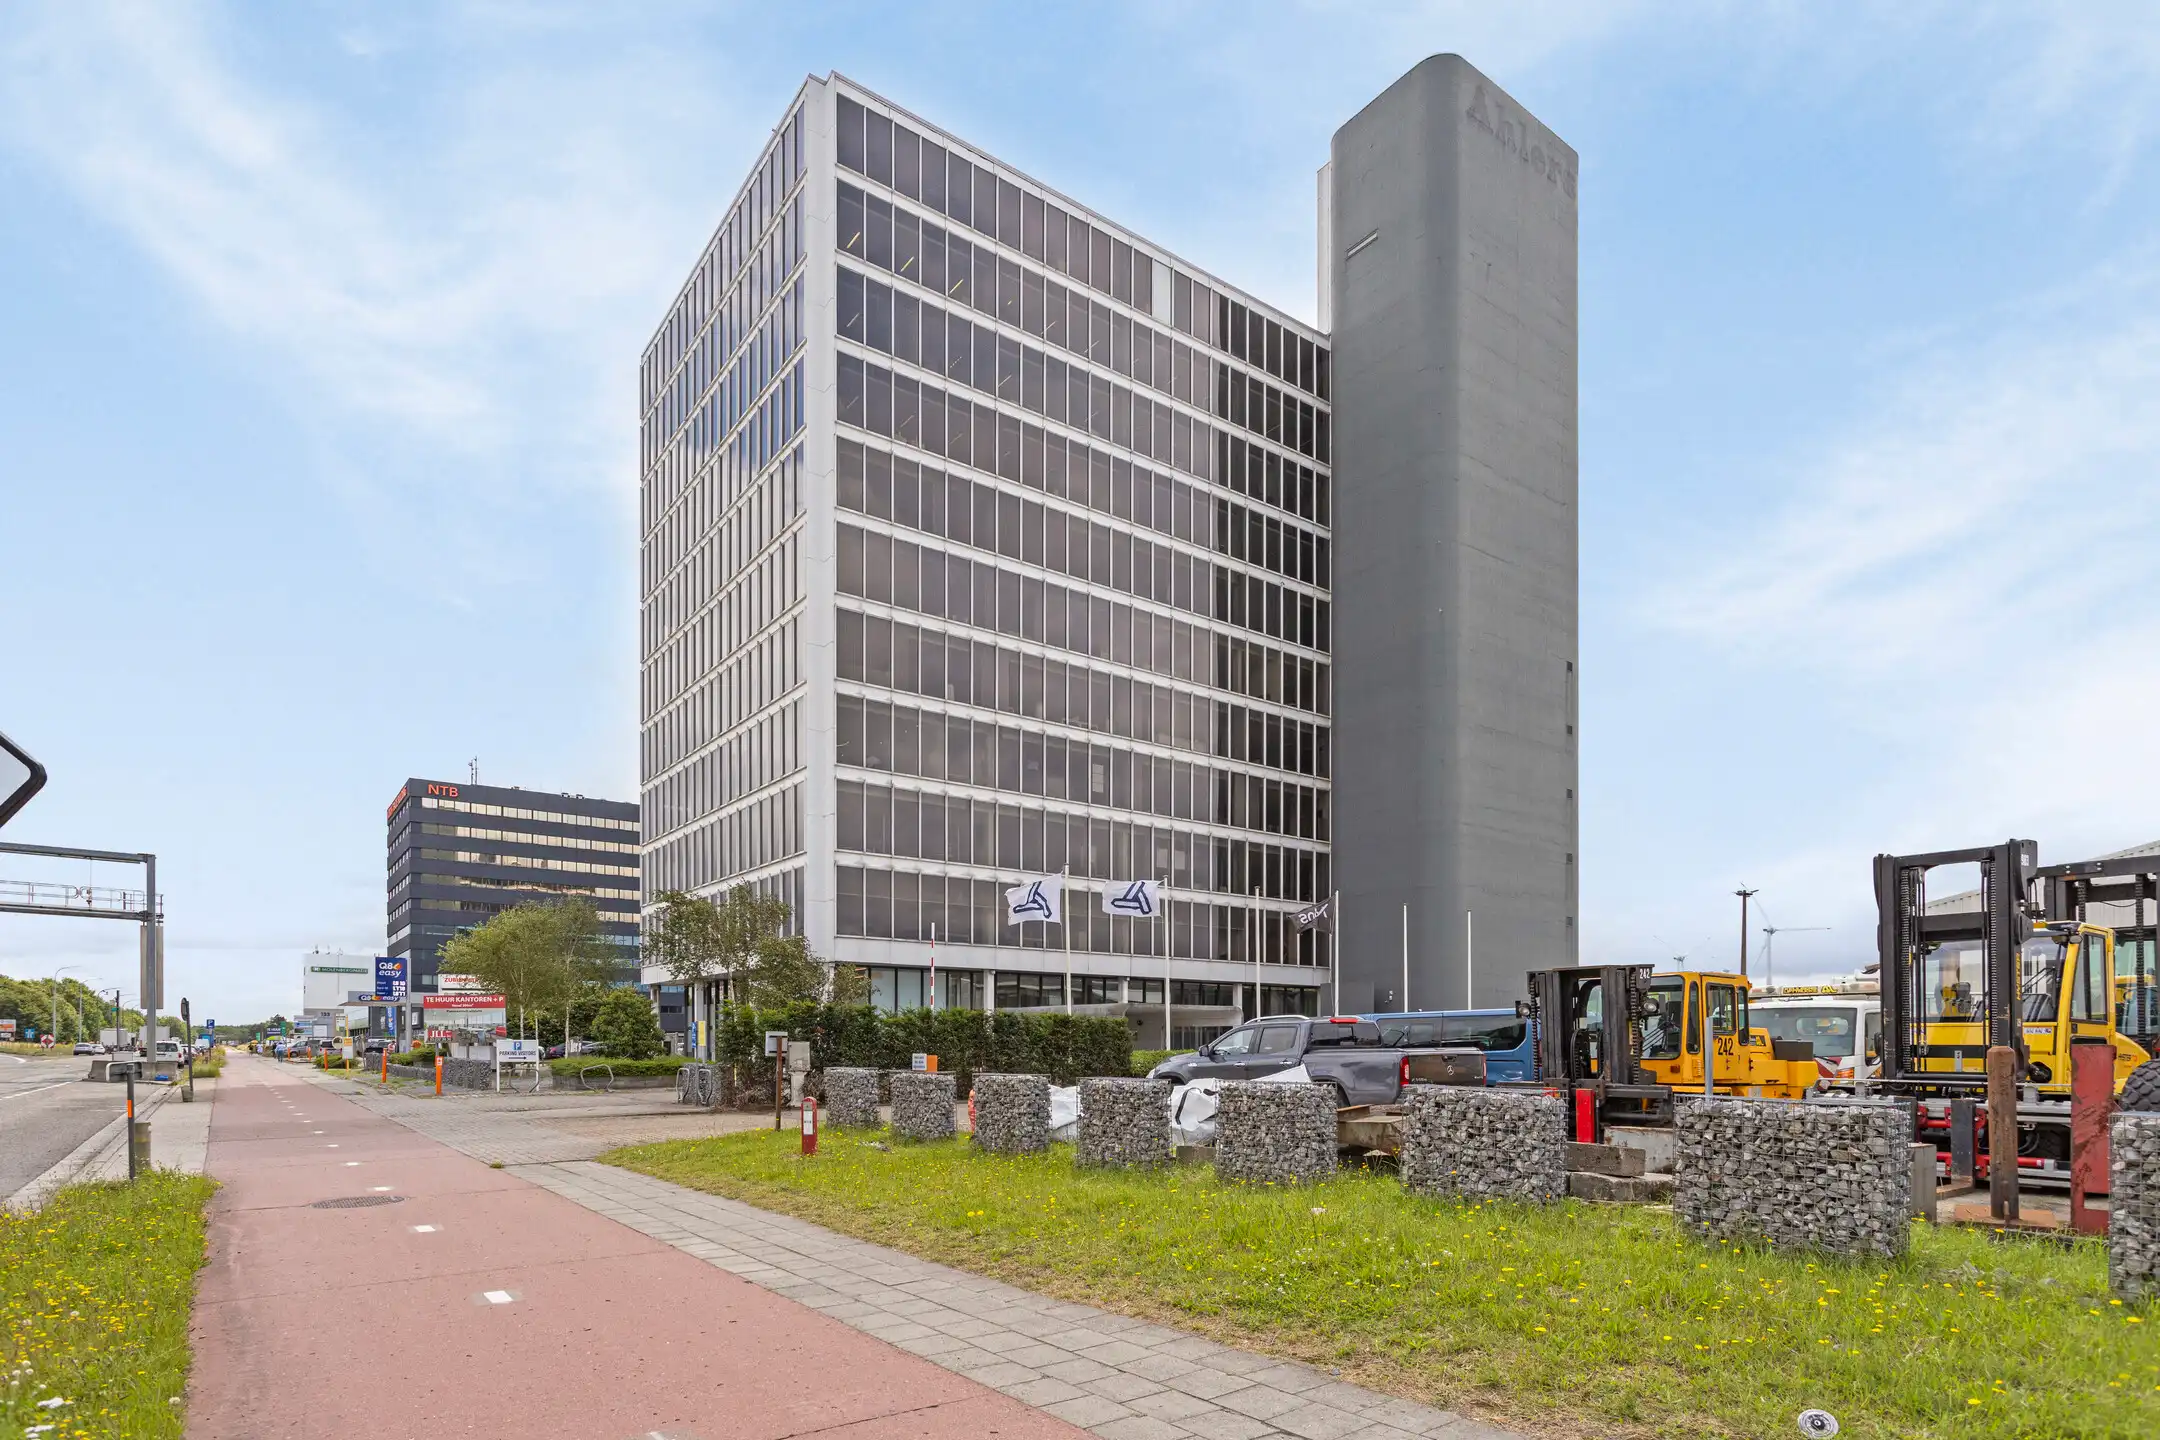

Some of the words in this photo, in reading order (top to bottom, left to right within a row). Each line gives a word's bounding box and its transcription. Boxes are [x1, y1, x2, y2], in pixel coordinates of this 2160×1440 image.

[428, 784, 458, 797] NTB
[379, 962, 393, 970] Q8
[379, 970, 401, 978] easy
[1640, 968, 1650, 979] 242
[1717, 1038, 1734, 1056] 242
